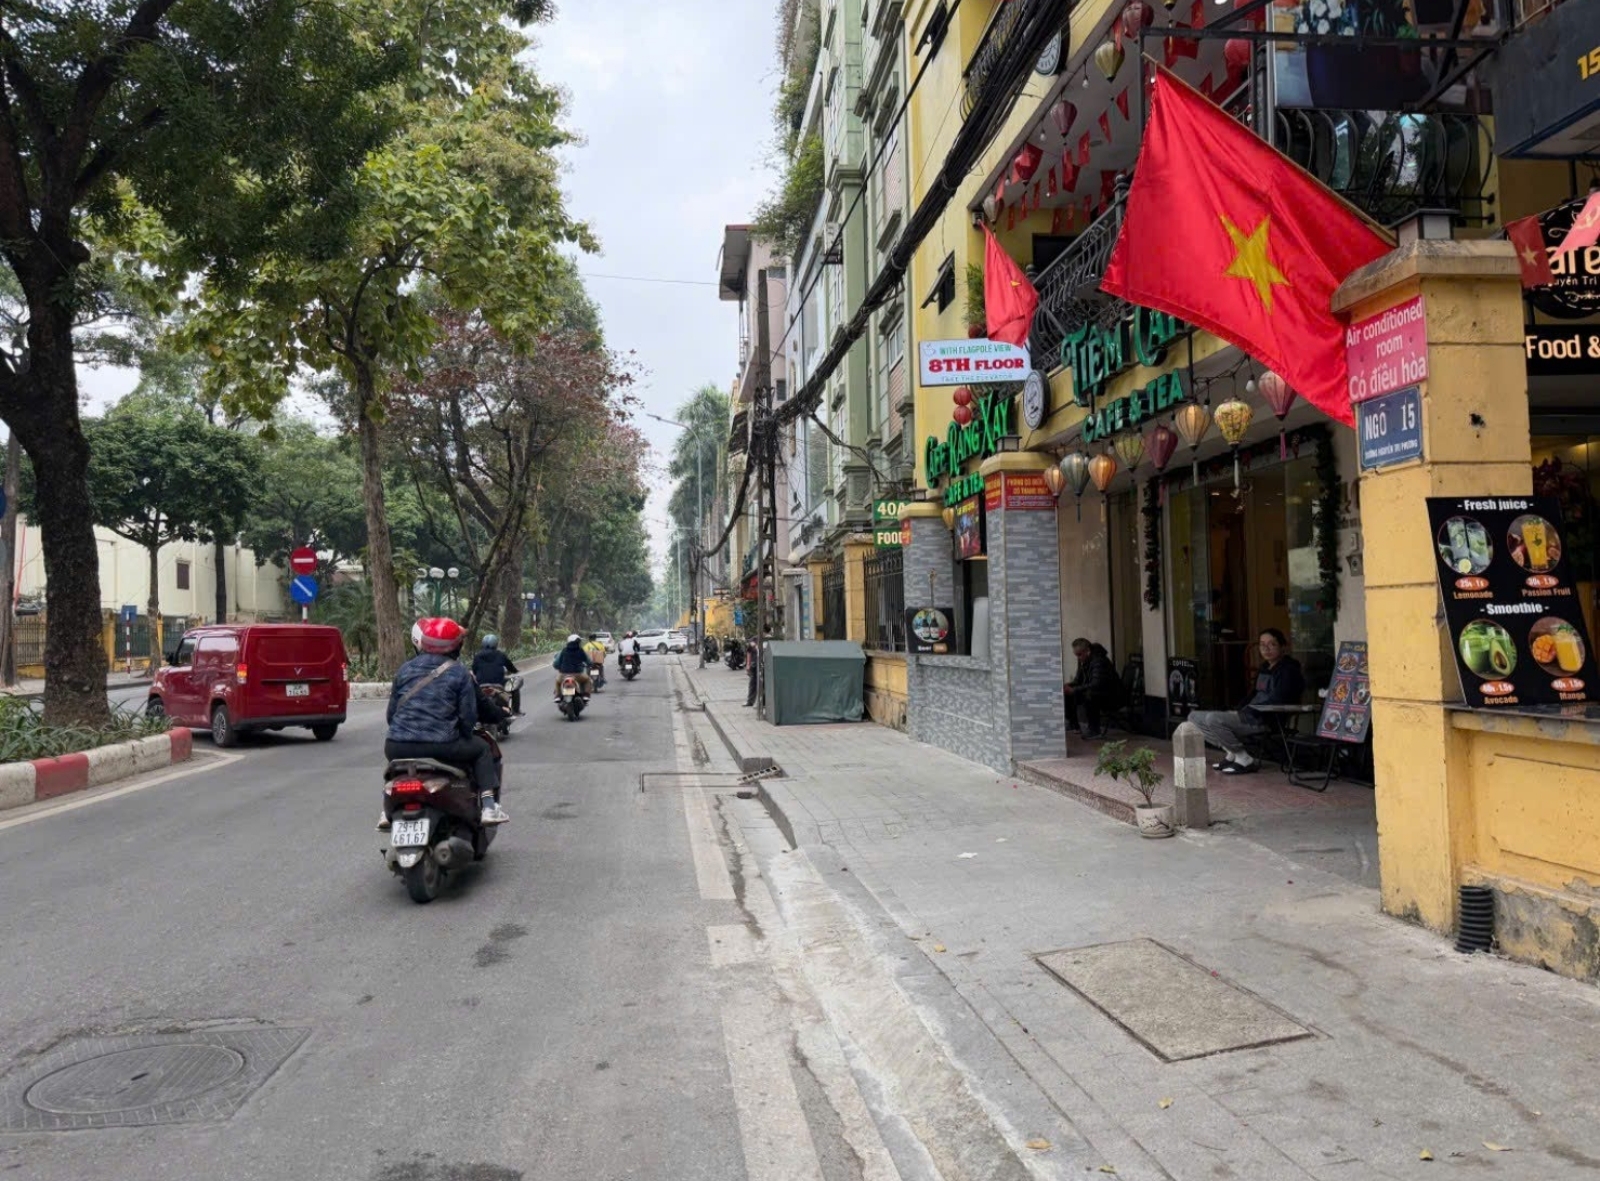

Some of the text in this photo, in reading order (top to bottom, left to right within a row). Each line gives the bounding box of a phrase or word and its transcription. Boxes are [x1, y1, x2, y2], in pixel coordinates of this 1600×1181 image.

[1346, 297, 1422, 347] Air conditioned
[940, 344, 1012, 355] WITH FLAGPOLE VIEW
[1377, 334, 1403, 358] room
[1525, 334, 1581, 359] Food
[928, 358, 1024, 373] 8TH FLOOR
[1349, 352, 1426, 399] Có điều hòa
[1082, 398, 1123, 444] CAFE
[1146, 368, 1183, 415] TEA
[1401, 403, 1416, 431] 15
[1464, 499, 1497, 511] Fresh
[1453, 590, 1494, 599] Lemonade
[1522, 587, 1571, 597] Passion Fruit
[1486, 602, 1543, 615] Smoothie
[1484, 695, 1519, 704] Avocado
